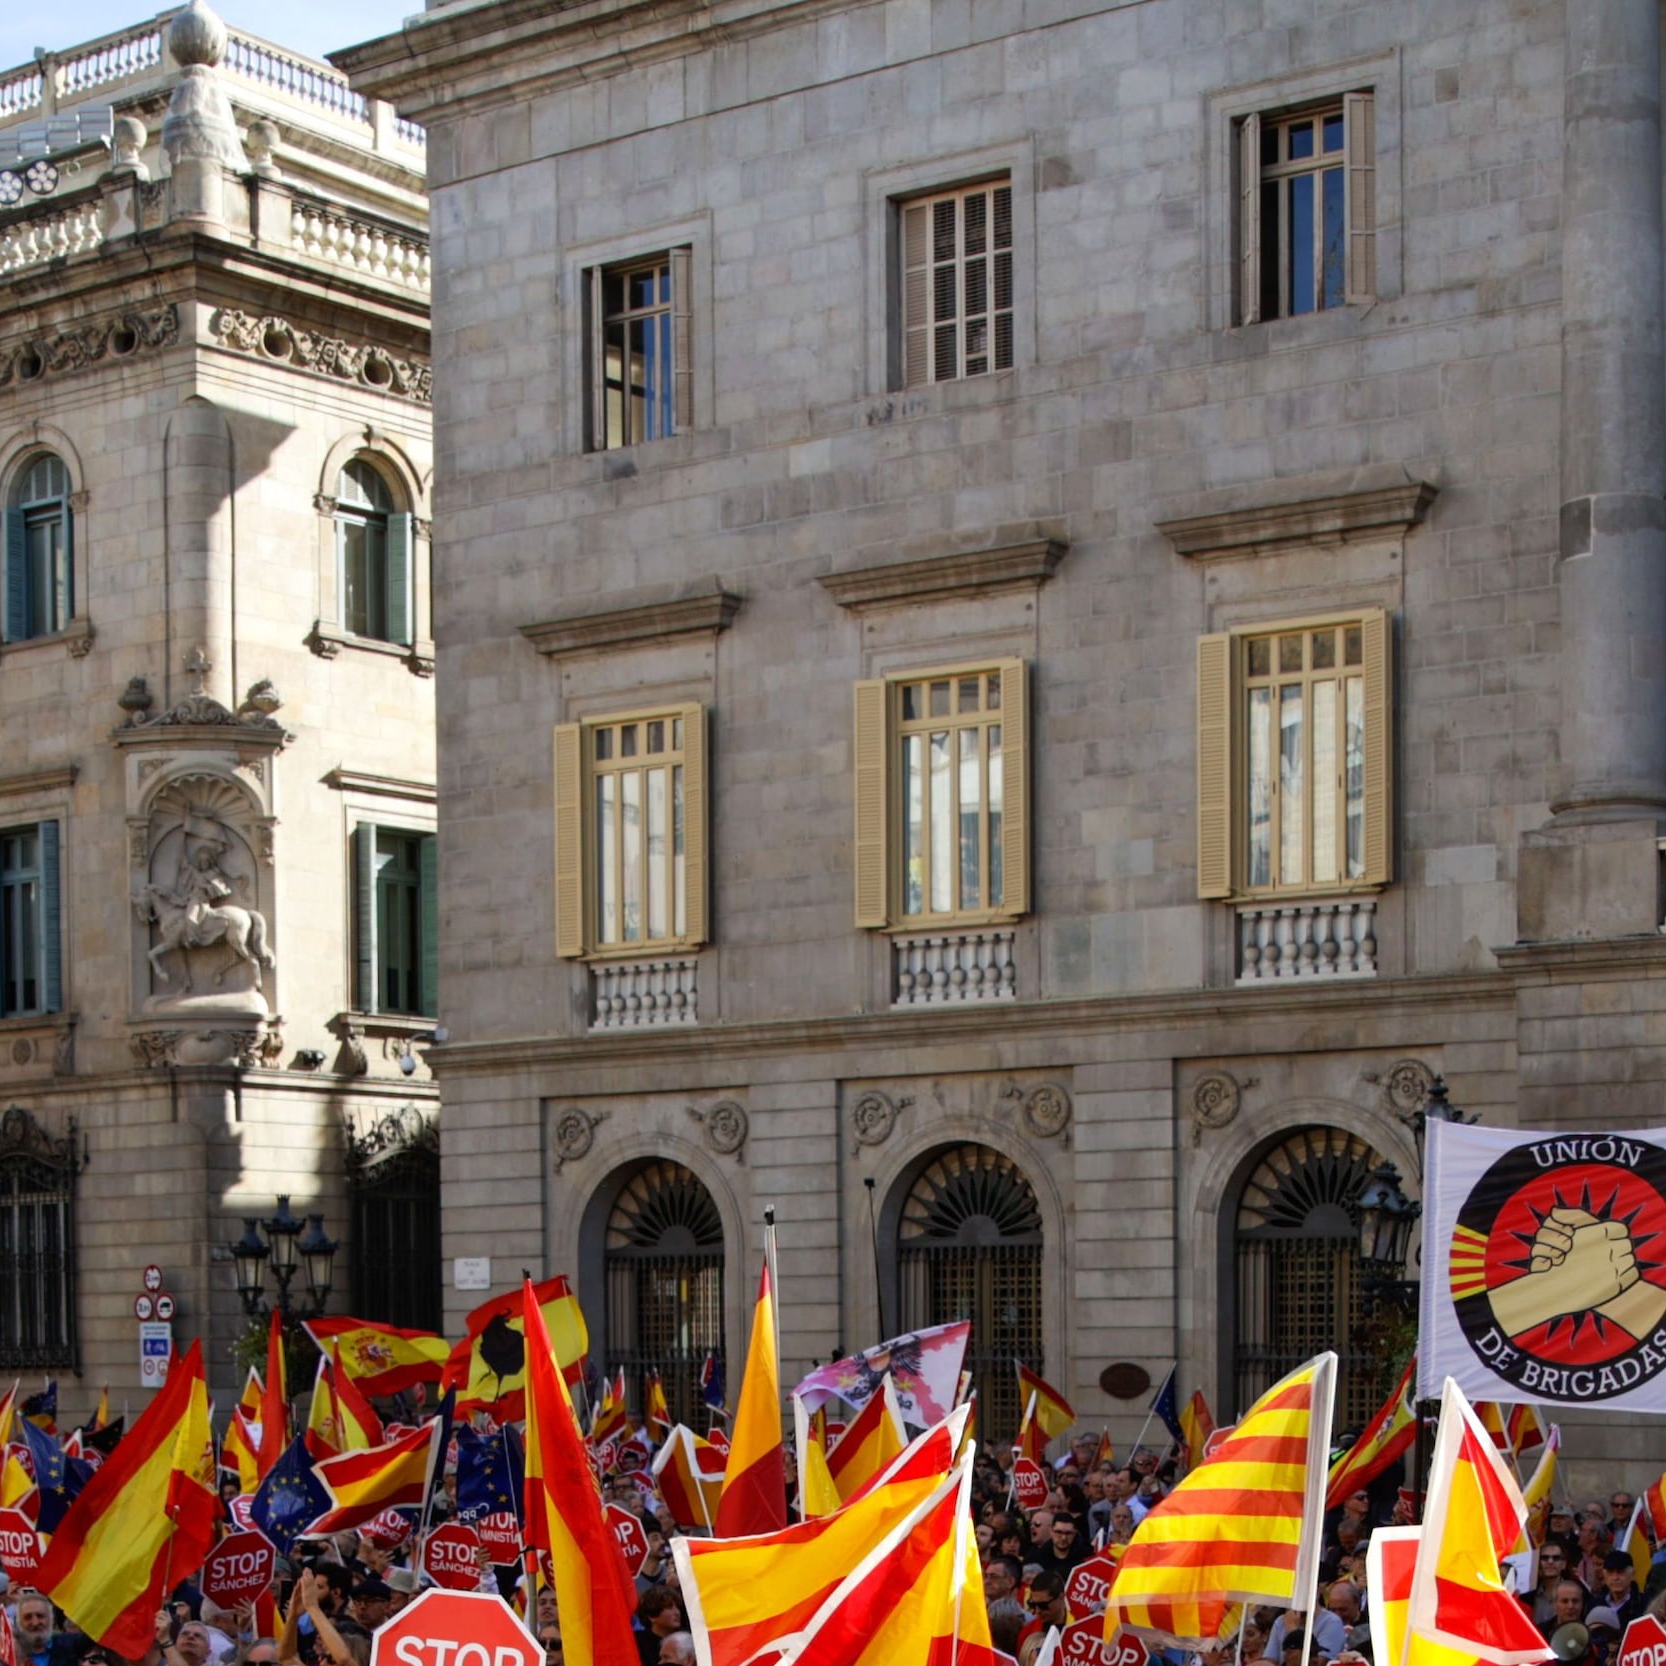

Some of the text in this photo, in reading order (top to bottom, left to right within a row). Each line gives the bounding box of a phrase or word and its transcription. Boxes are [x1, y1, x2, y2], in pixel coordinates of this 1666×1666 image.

[1530, 1135, 1645, 1168] UNIÓN
[1475, 1327, 1520, 1370] DE
[1015, 1472, 1040, 1487] STOP
[212, 1549, 269, 1581] STOP
[430, 1562, 481, 1578] SÁNCHEZ
[210, 1572, 266, 1592] SÁNCHEZ
[1076, 1571, 1111, 1601] STO
